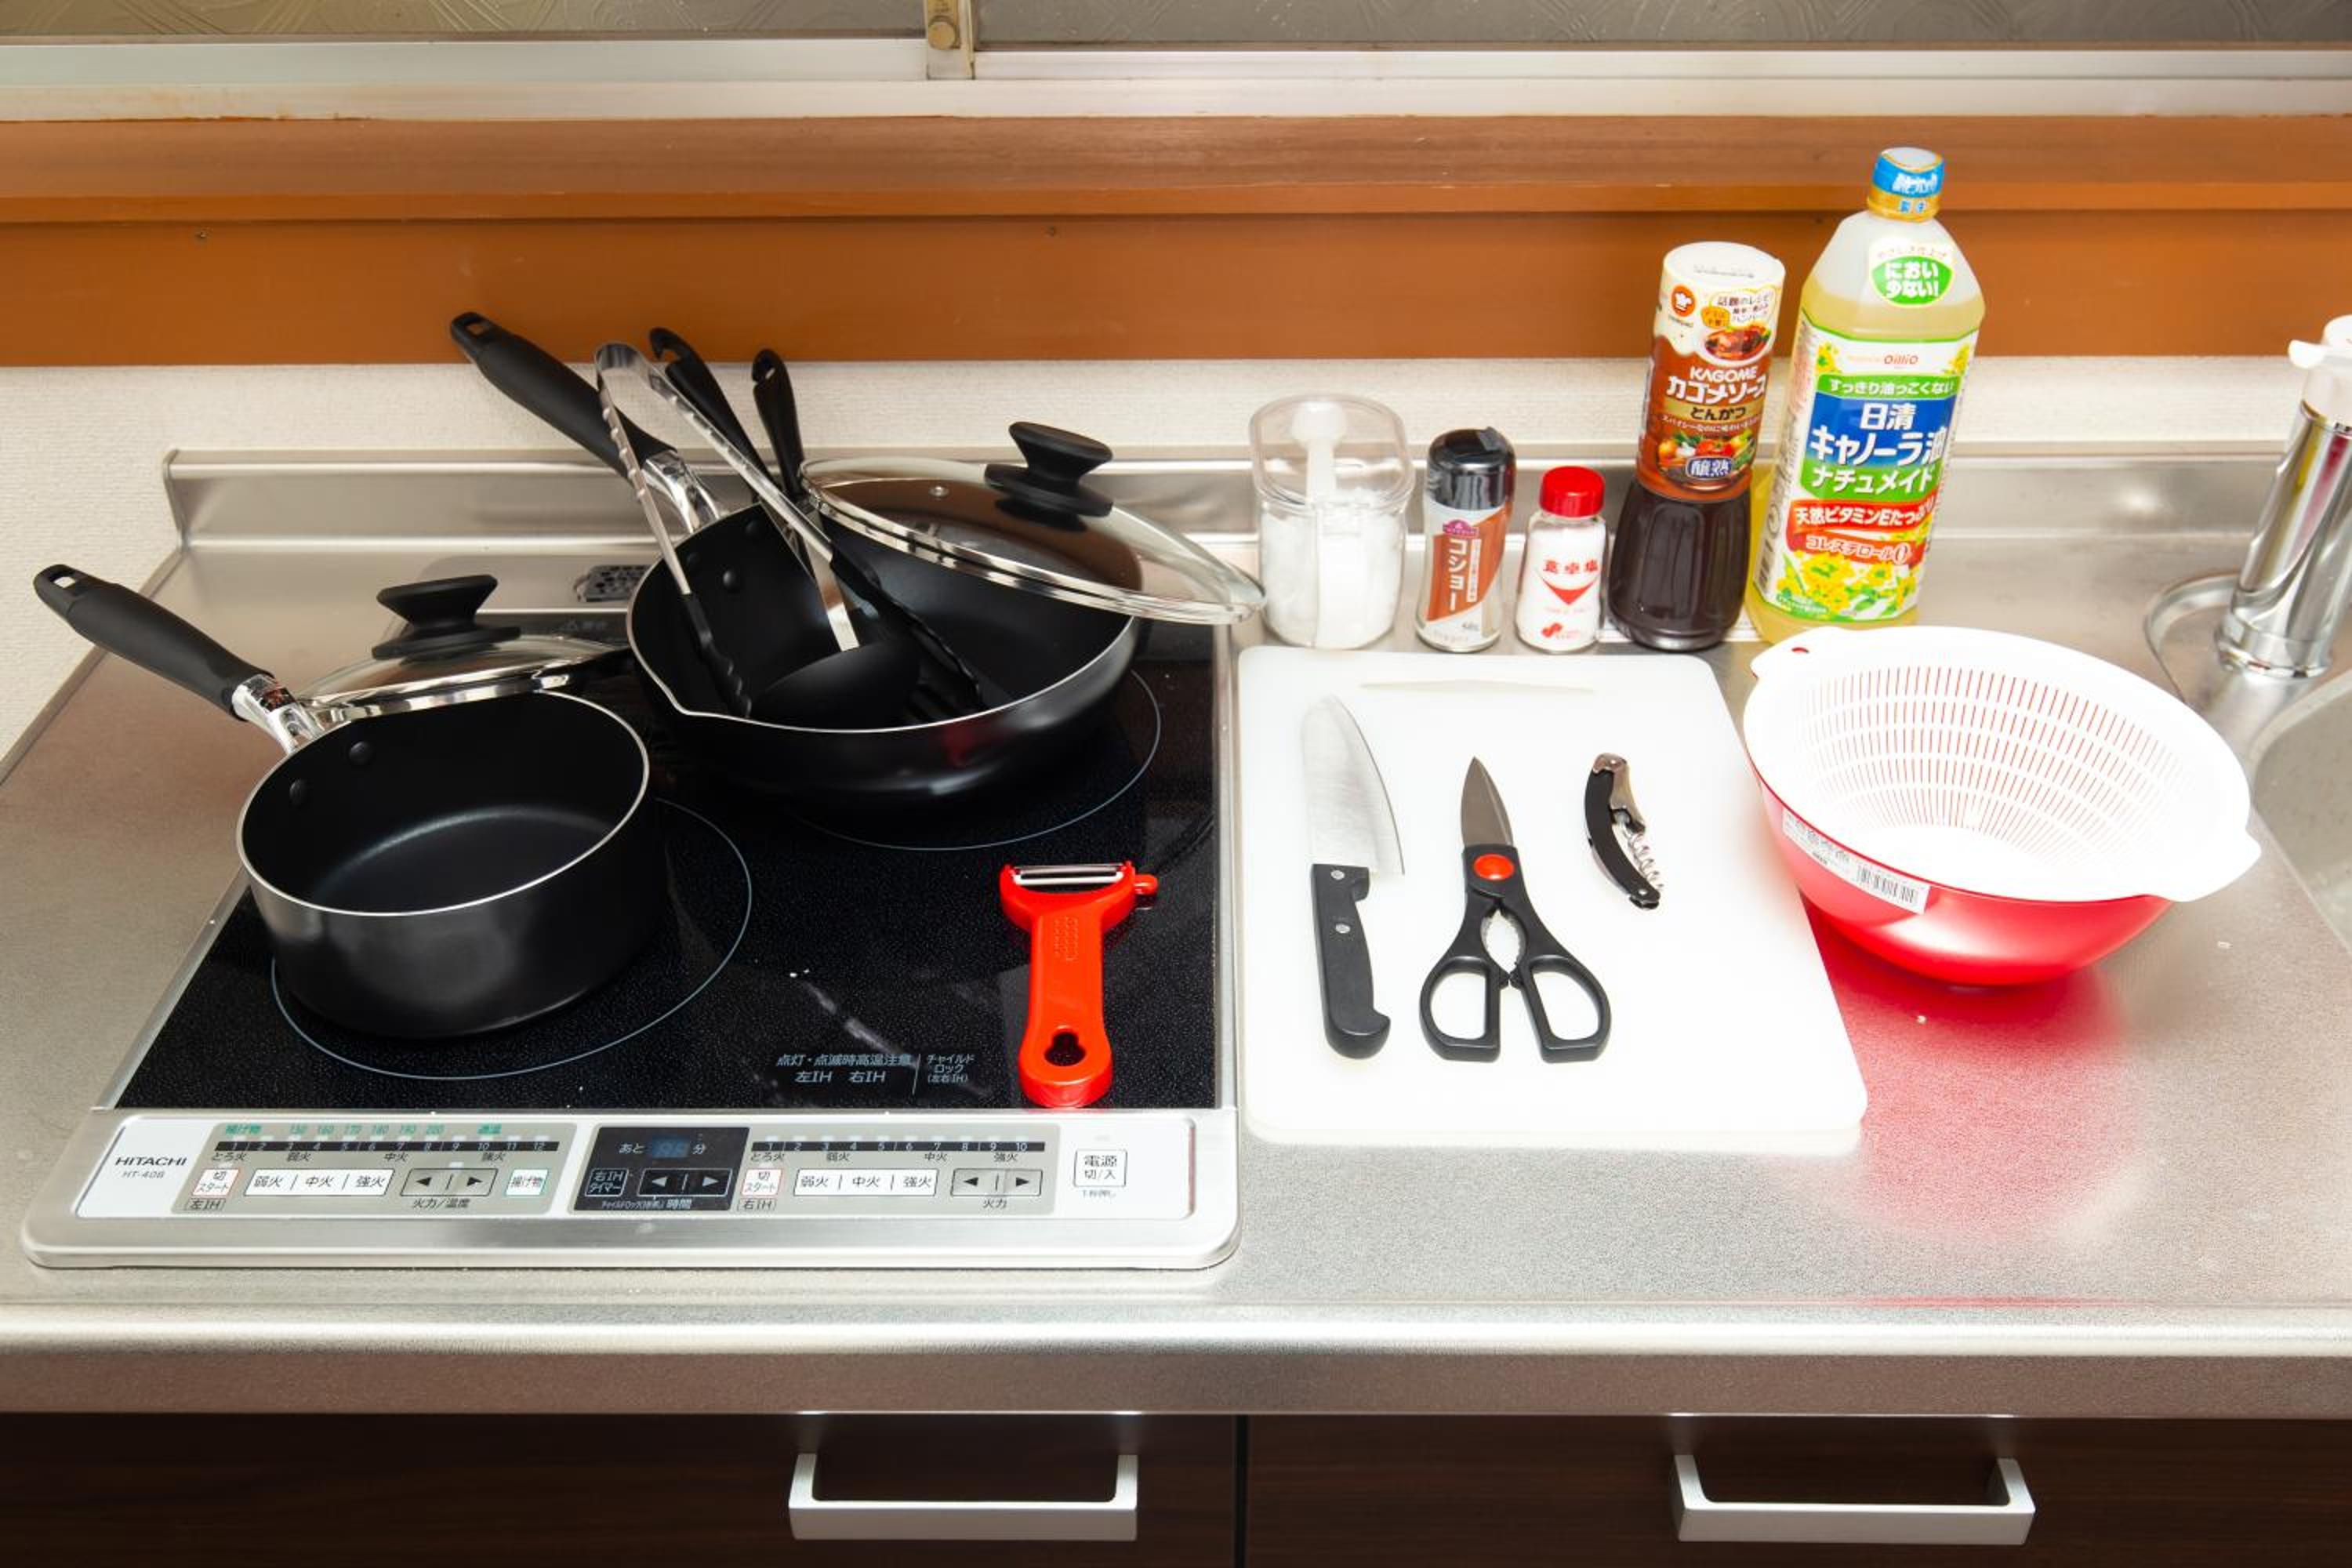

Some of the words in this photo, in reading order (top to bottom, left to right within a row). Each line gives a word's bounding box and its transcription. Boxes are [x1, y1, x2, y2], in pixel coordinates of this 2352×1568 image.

[1886, 262, 1939, 279] におい
[1690, 366, 1759, 383] KAGOME
[1666, 374, 1767, 404] カゴメソース
[1830, 379, 1954, 394] すっきり油っこくない
[1690, 407, 1746, 421] とんかつ
[1860, 403, 1916, 430] 日清
[1809, 425, 1947, 466] キャノーラ油
[1811, 465, 1933, 495] ナチュメイド
[1795, 495, 1936, 525] 天然ビタミンEたっぷり
[1448, 538, 1468, 611] コショー
[927, 1054, 975, 1063] チャイルド
[934, 1064, 964, 1073] ロック
[795, 1071, 833, 1083] 左IH
[849, 1071, 887, 1083] 右IH
[768, 1142, 773, 1151] 1
[793, 1142, 803, 1151] 2
[822, 1142, 829, 1151] 3
[849, 1142, 858, 1151] 4
[877, 1142, 885, 1151] 5
[906, 1142, 913, 1151] 6
[934, 1142, 941, 1151] 7
[961, 1142, 968, 1151] 8
[989, 1142, 997, 1151] 9
[1016, 1142, 1027, 1151] 10
[115, 1157, 187, 1166] HITACHI
[212, 1152, 247, 1161] とろ火
[383, 1152, 408, 1162] 中火
[750, 1152, 785, 1162] とろ火
[826, 1152, 851, 1162] 弱火
[924, 1152, 948, 1162] 中火
[994, 1152, 1018, 1162] 強火
[1084, 1155, 1117, 1167] 電源
[212, 1171, 226, 1181] 切
[595, 1171, 623, 1181] 右IH
[758, 1171, 771, 1181] 切
[1085, 1169, 1116, 1180] 切/入
[253, 1176, 283, 1188] 弱火
[305, 1176, 334, 1188] 中火
[356, 1175, 386, 1188] 強火
[800, 1177, 828, 1188] 弱火
[852, 1177, 880, 1188] 中火
[902, 1177, 931, 1188] 強火
[200, 1183, 228, 1193] スタート
[590, 1183, 622, 1193] タイマー
[746, 1183, 775, 1192] スタート
[982, 1199, 1007, 1209] 火力
